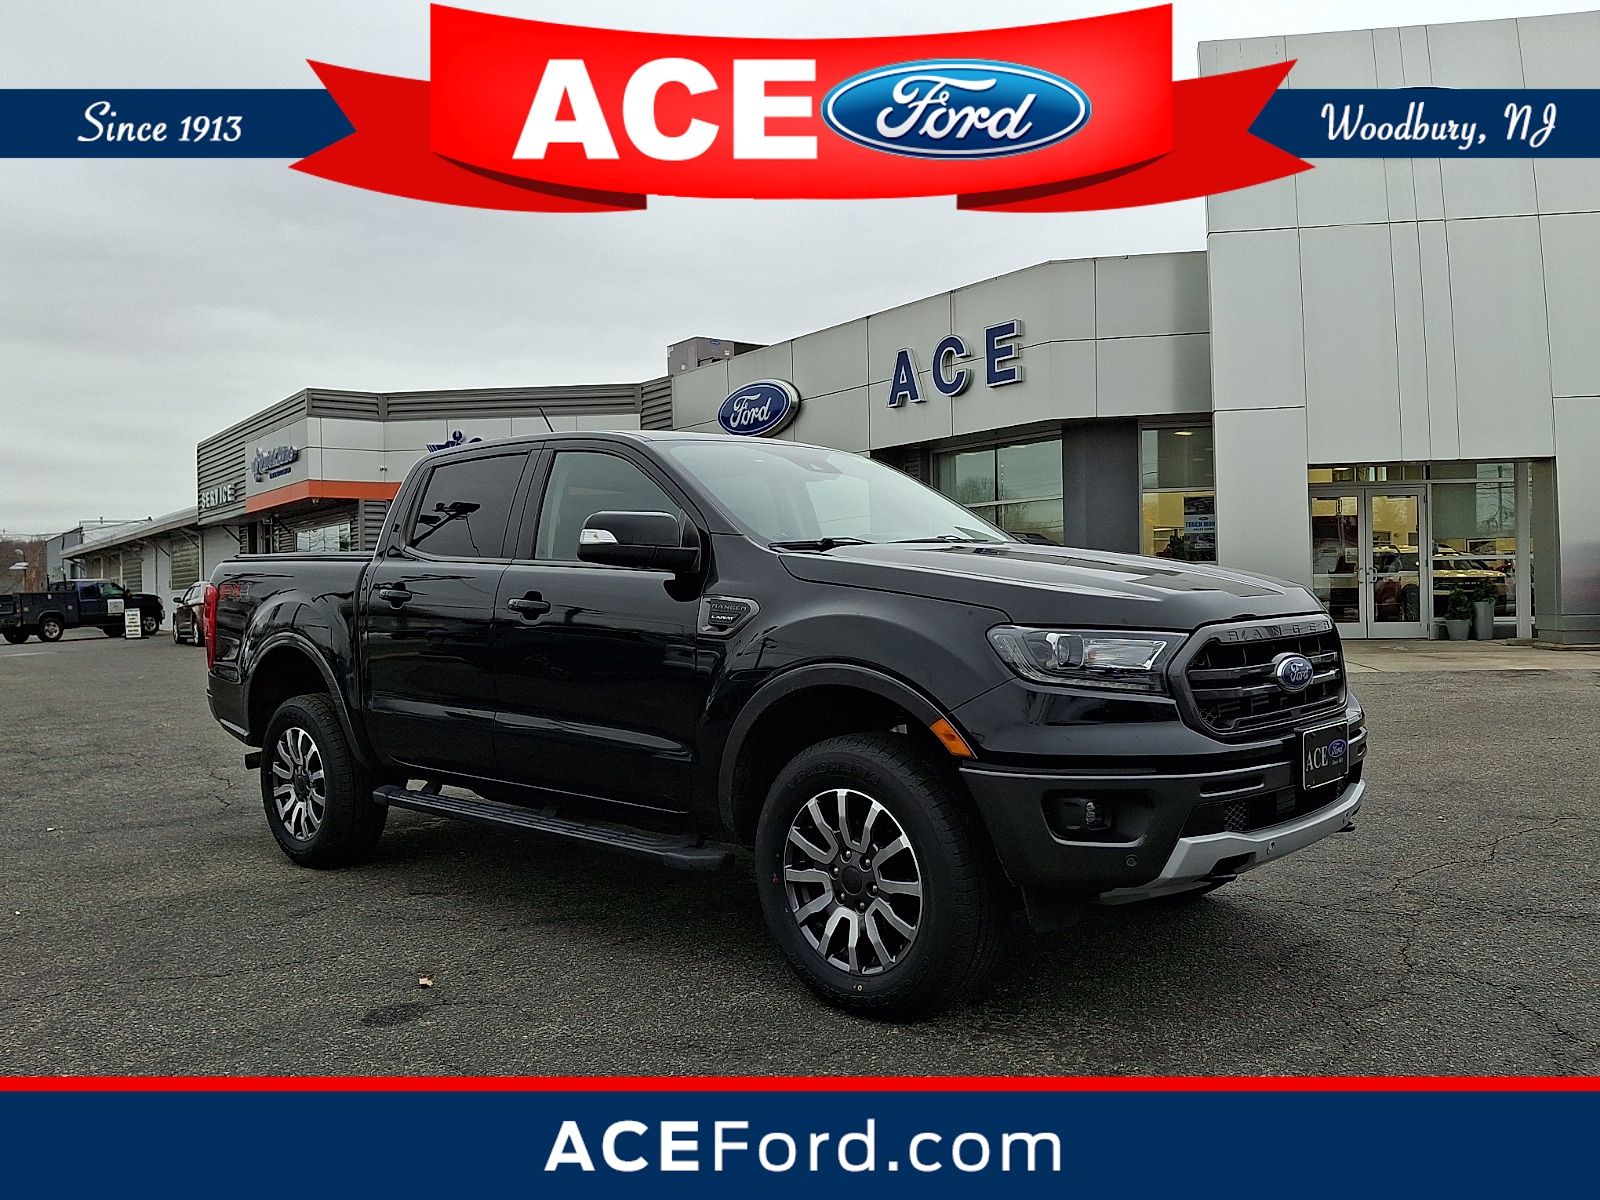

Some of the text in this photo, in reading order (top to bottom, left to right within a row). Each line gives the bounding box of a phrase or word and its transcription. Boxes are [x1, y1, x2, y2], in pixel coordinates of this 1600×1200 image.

[887, 319, 1023, 408] ACE
[729, 392, 773, 428] Ford
[201, 484, 235, 509] SERVICE
[220, 582, 252, 600] FX4
[711, 603, 747, 611] RANGER
[1227, 620, 1334, 641] RANGER
[1306, 746, 1328, 771] ACE
